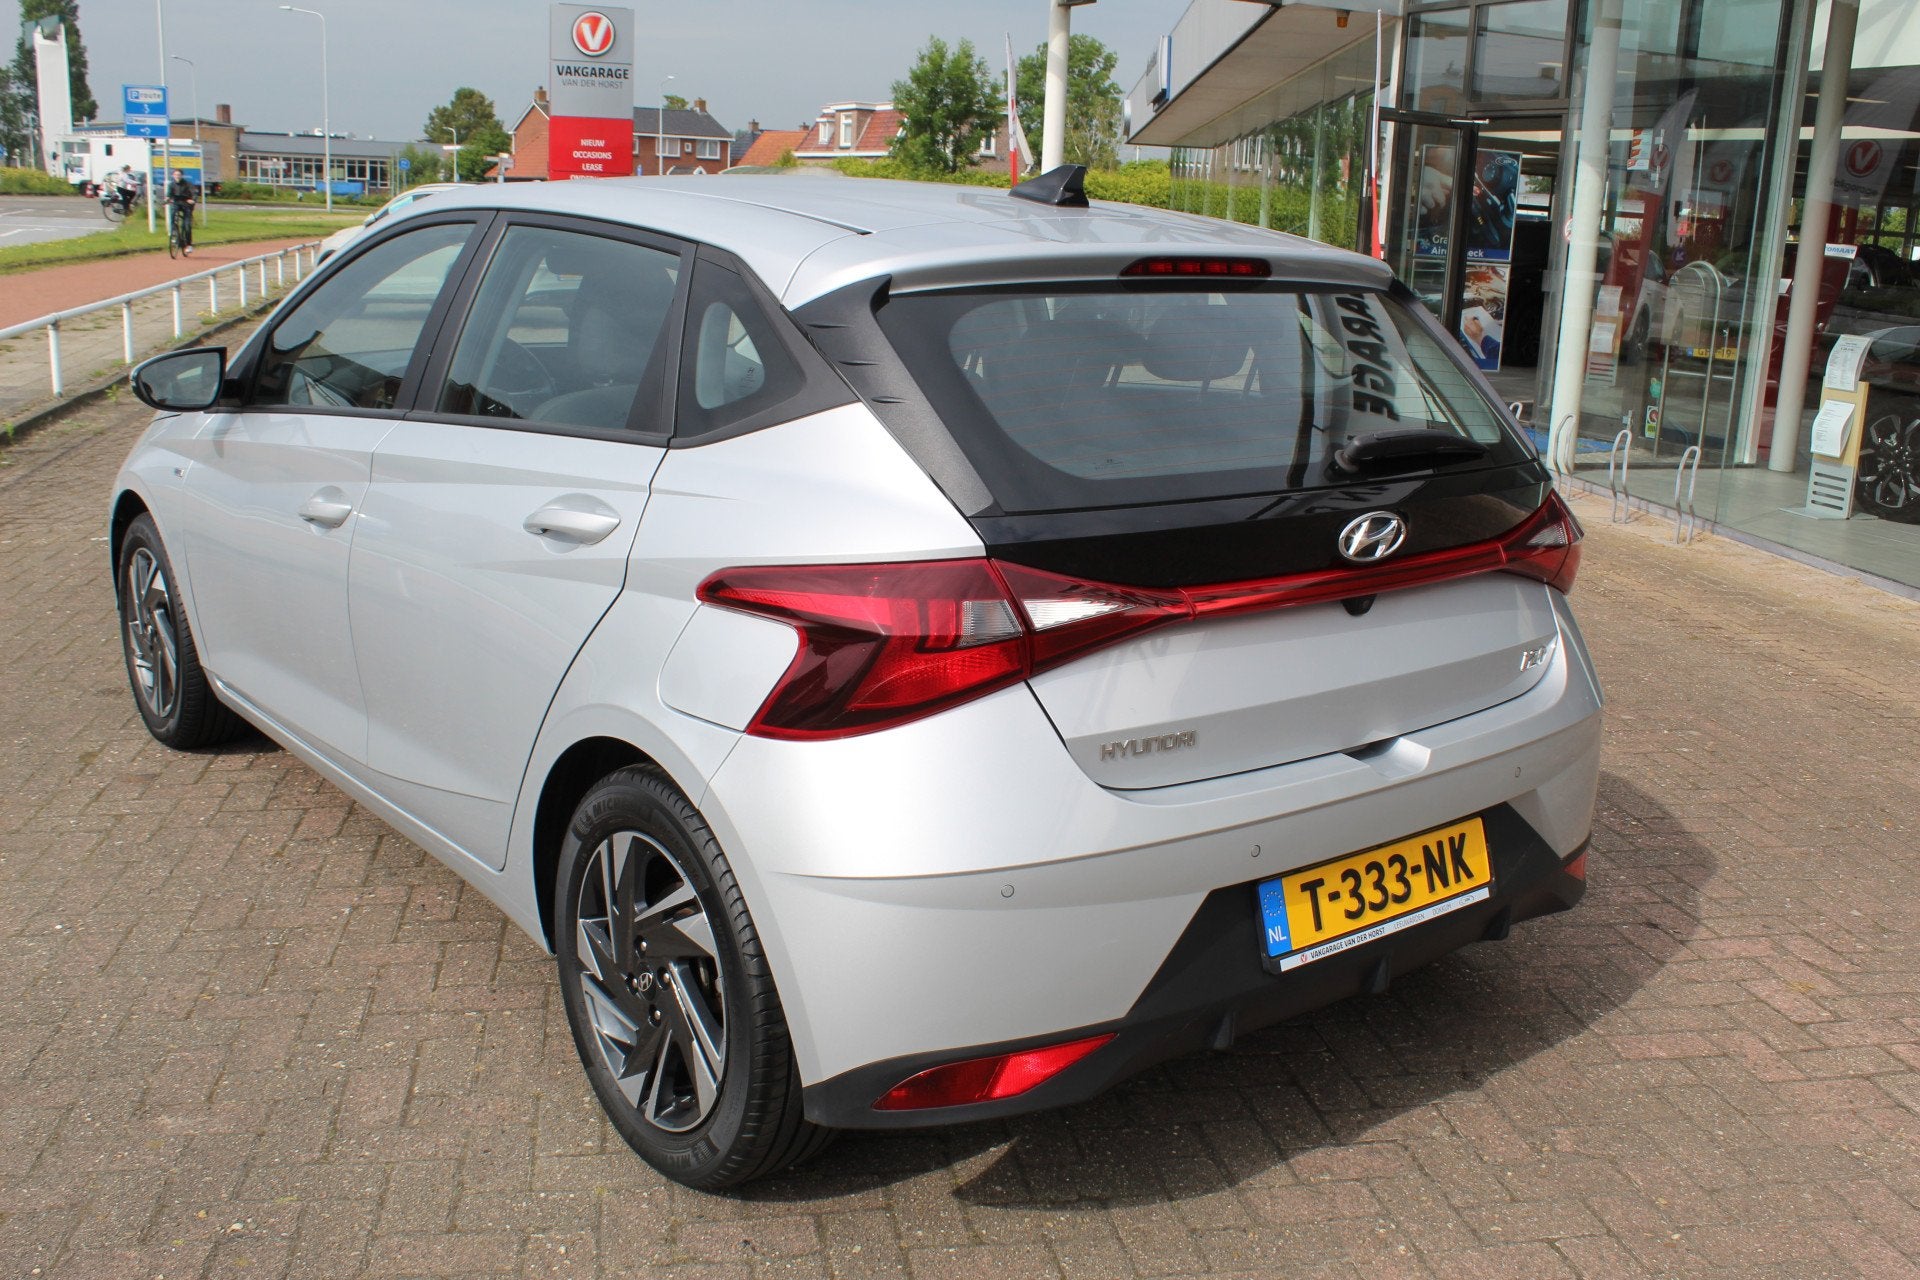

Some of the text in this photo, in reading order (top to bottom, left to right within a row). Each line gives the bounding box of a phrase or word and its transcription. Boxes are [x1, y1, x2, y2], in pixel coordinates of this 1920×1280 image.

[556, 65, 629, 79] VAKGARAGE
[561, 79, 624, 90] VAN DER HORST
[580, 138, 605, 147] NIEUW
[572, 150, 613, 160] OCCASIONS
[582, 163, 603, 171] LEASE
[1432, 235, 1448, 244] Gra
[1467, 249, 1484, 257] eck
[1825, 245, 1855, 255] OMAAT
[1100, 729, 1197, 761] HYUNDAI
[1300, 833, 1474, 931] T-333-NK
[1268, 926, 1286, 943] NL
[1310, 943, 1344, 959] VAKGARAGE
[1344, 937, 1355, 947] VAN
[1356, 933, 1367, 943] DER
[1368, 927, 1385, 939] HORST
